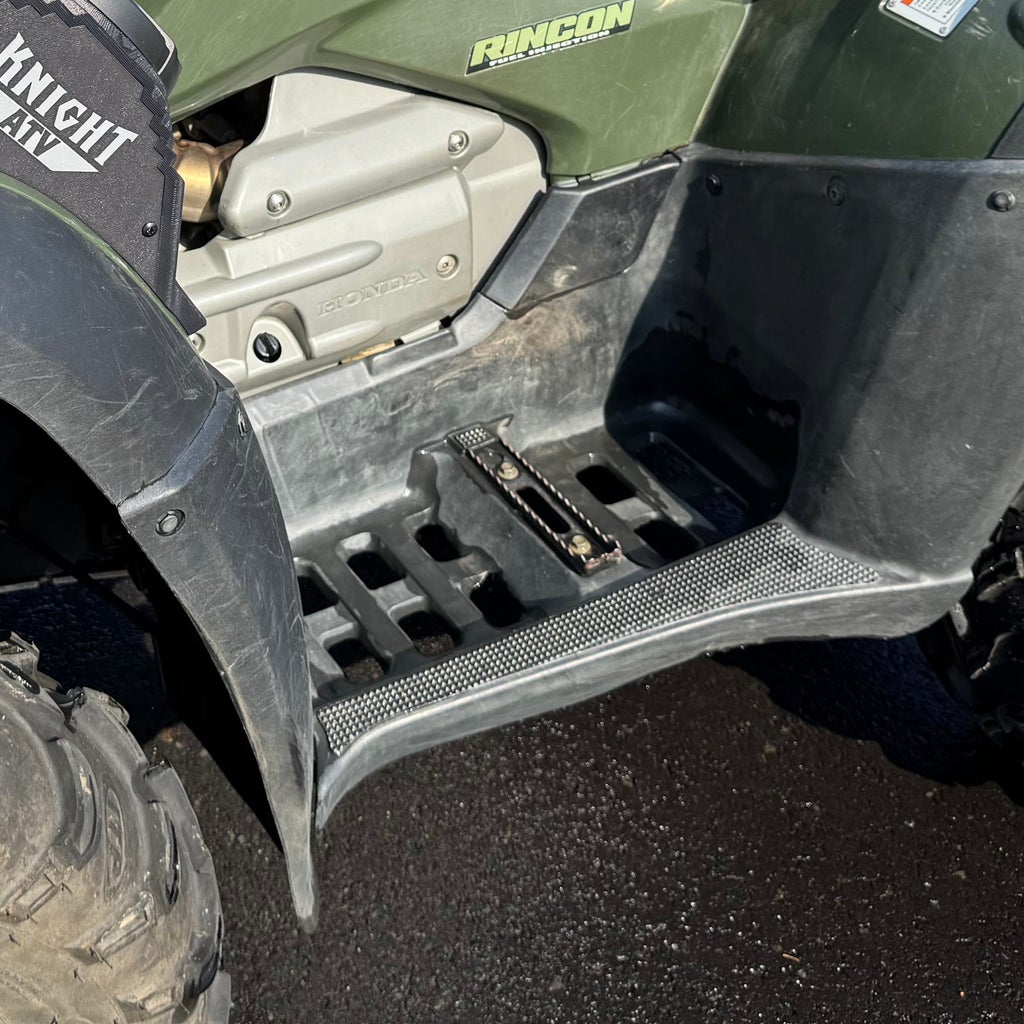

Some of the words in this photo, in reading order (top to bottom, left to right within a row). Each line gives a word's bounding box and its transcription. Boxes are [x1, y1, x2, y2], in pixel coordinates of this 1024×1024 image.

[488, 52, 526, 67] FUEL
[528, 29, 610, 56] INJECTION
[318, 269, 429, 318] HONDA
